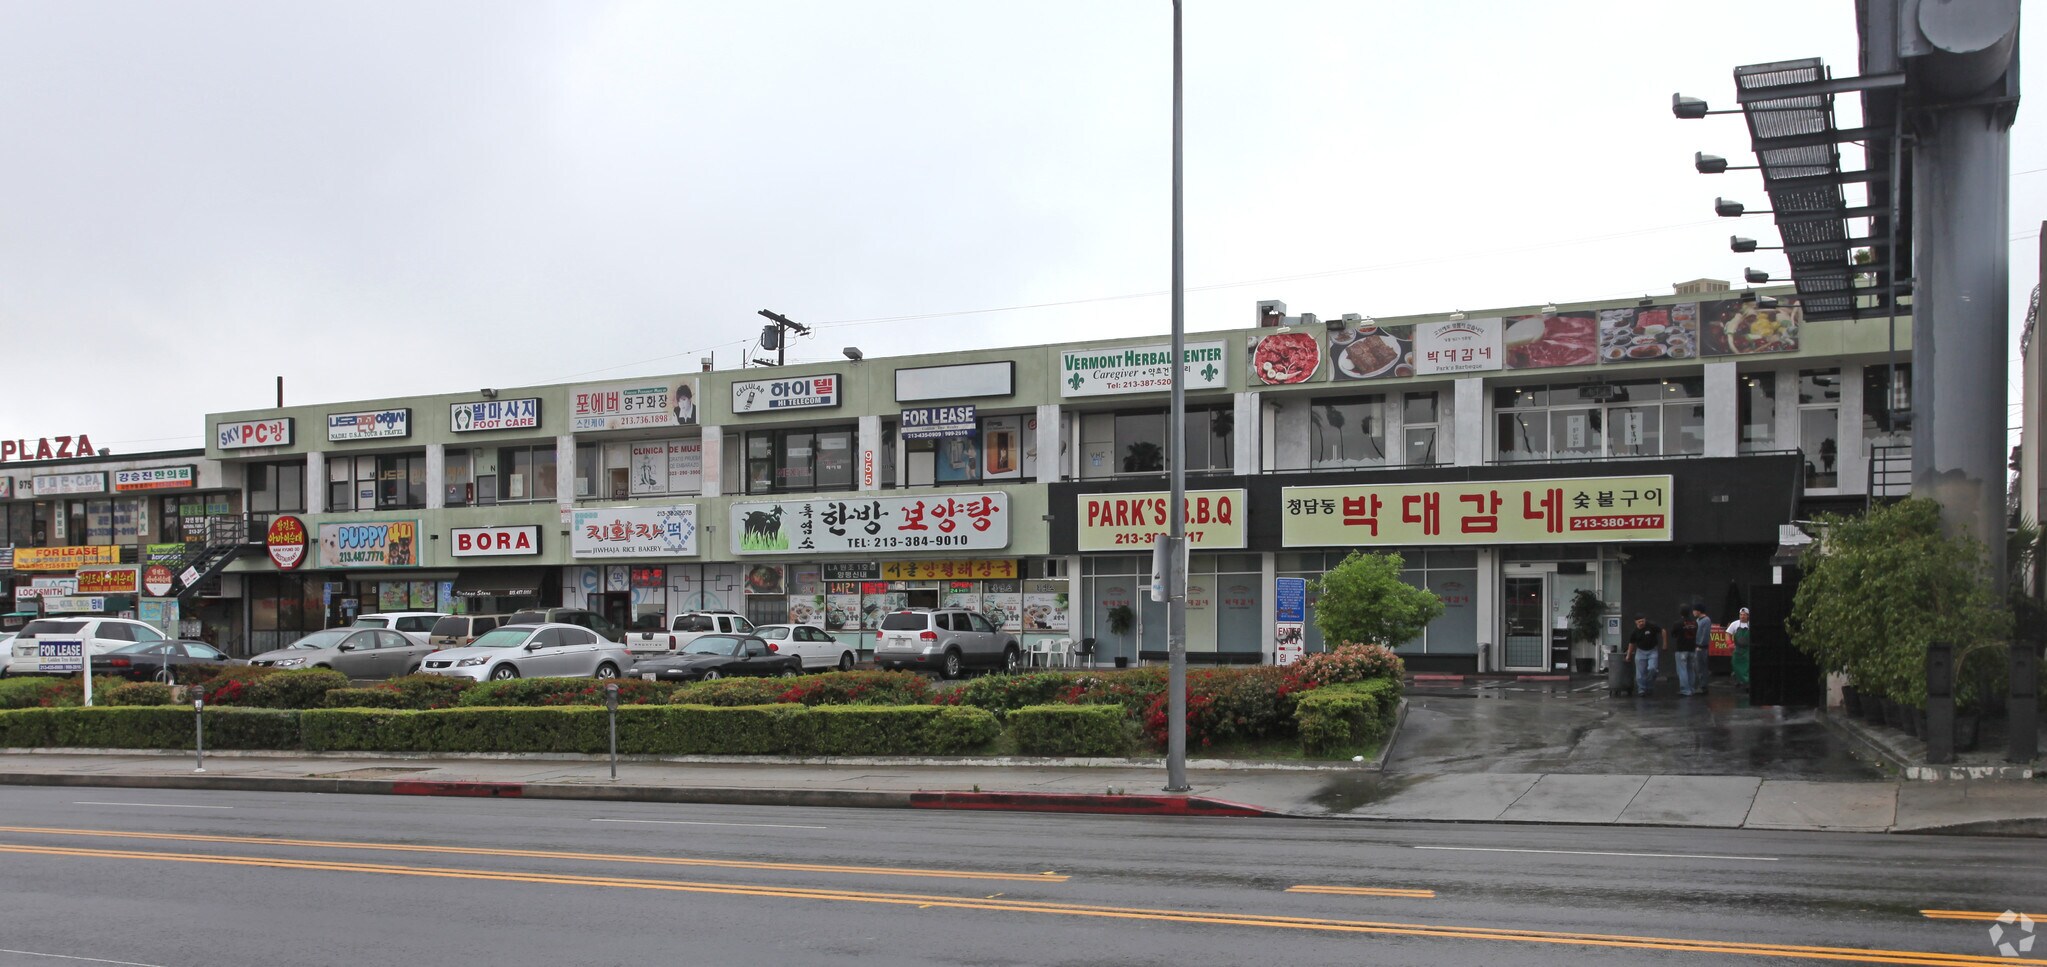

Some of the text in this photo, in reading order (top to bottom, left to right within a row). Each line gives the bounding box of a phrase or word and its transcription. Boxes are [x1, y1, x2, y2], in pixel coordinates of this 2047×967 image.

[1183, 347, 1222, 363] ENTER
[1427, 346, 1492, 363] 박대감네
[1093, 368, 1139, 380] Caregiver
[1148, 366, 1191, 377] 약초건리
[736, 383, 765, 397] CELLULAR
[1106, 379, 1173, 390] Tel: 213-387-520
[576, 391, 668, 414] 포에버 영구화장
[777, 397, 822, 407] HI TELECOM
[472, 400, 535, 421] 발마사지
[902, 406, 974, 426] FOR LEASE
[473, 418, 534, 429] FOOT CARE
[576, 418, 605, 429] 스킨케어
[621, 415, 668, 426] 213.736.1898
[220, 421, 285, 446] SKY PC방
[1, 434, 95, 463] PLAZA
[633, 446, 664, 456] CLINICA
[369, 471, 375, 479] M
[864, 450, 873, 486] 955
[19, 480, 32, 490] 975
[1571, 486, 1663, 510] 숯불구이
[1088, 497, 1167, 528] PARK'S
[1286, 487, 1564, 537] 청담동 박대감네
[797, 496, 1000, 550] 흑염소 한방 보양탕
[1573, 516, 1662, 529] 213-380-1717
[338, 524, 389, 549] PUPPY
[586, 519, 682, 543] 지화자 떡
[457, 531, 531, 551] BORA
[848, 534, 968, 548] TEL: 213-384-9010
[35, 547, 98, 557] FOR LEASE
[887, 562, 919, 578] 서울
[18, 588, 63, 597] LOCKSMITH
[40, 644, 81, 656] FOR LEASE
